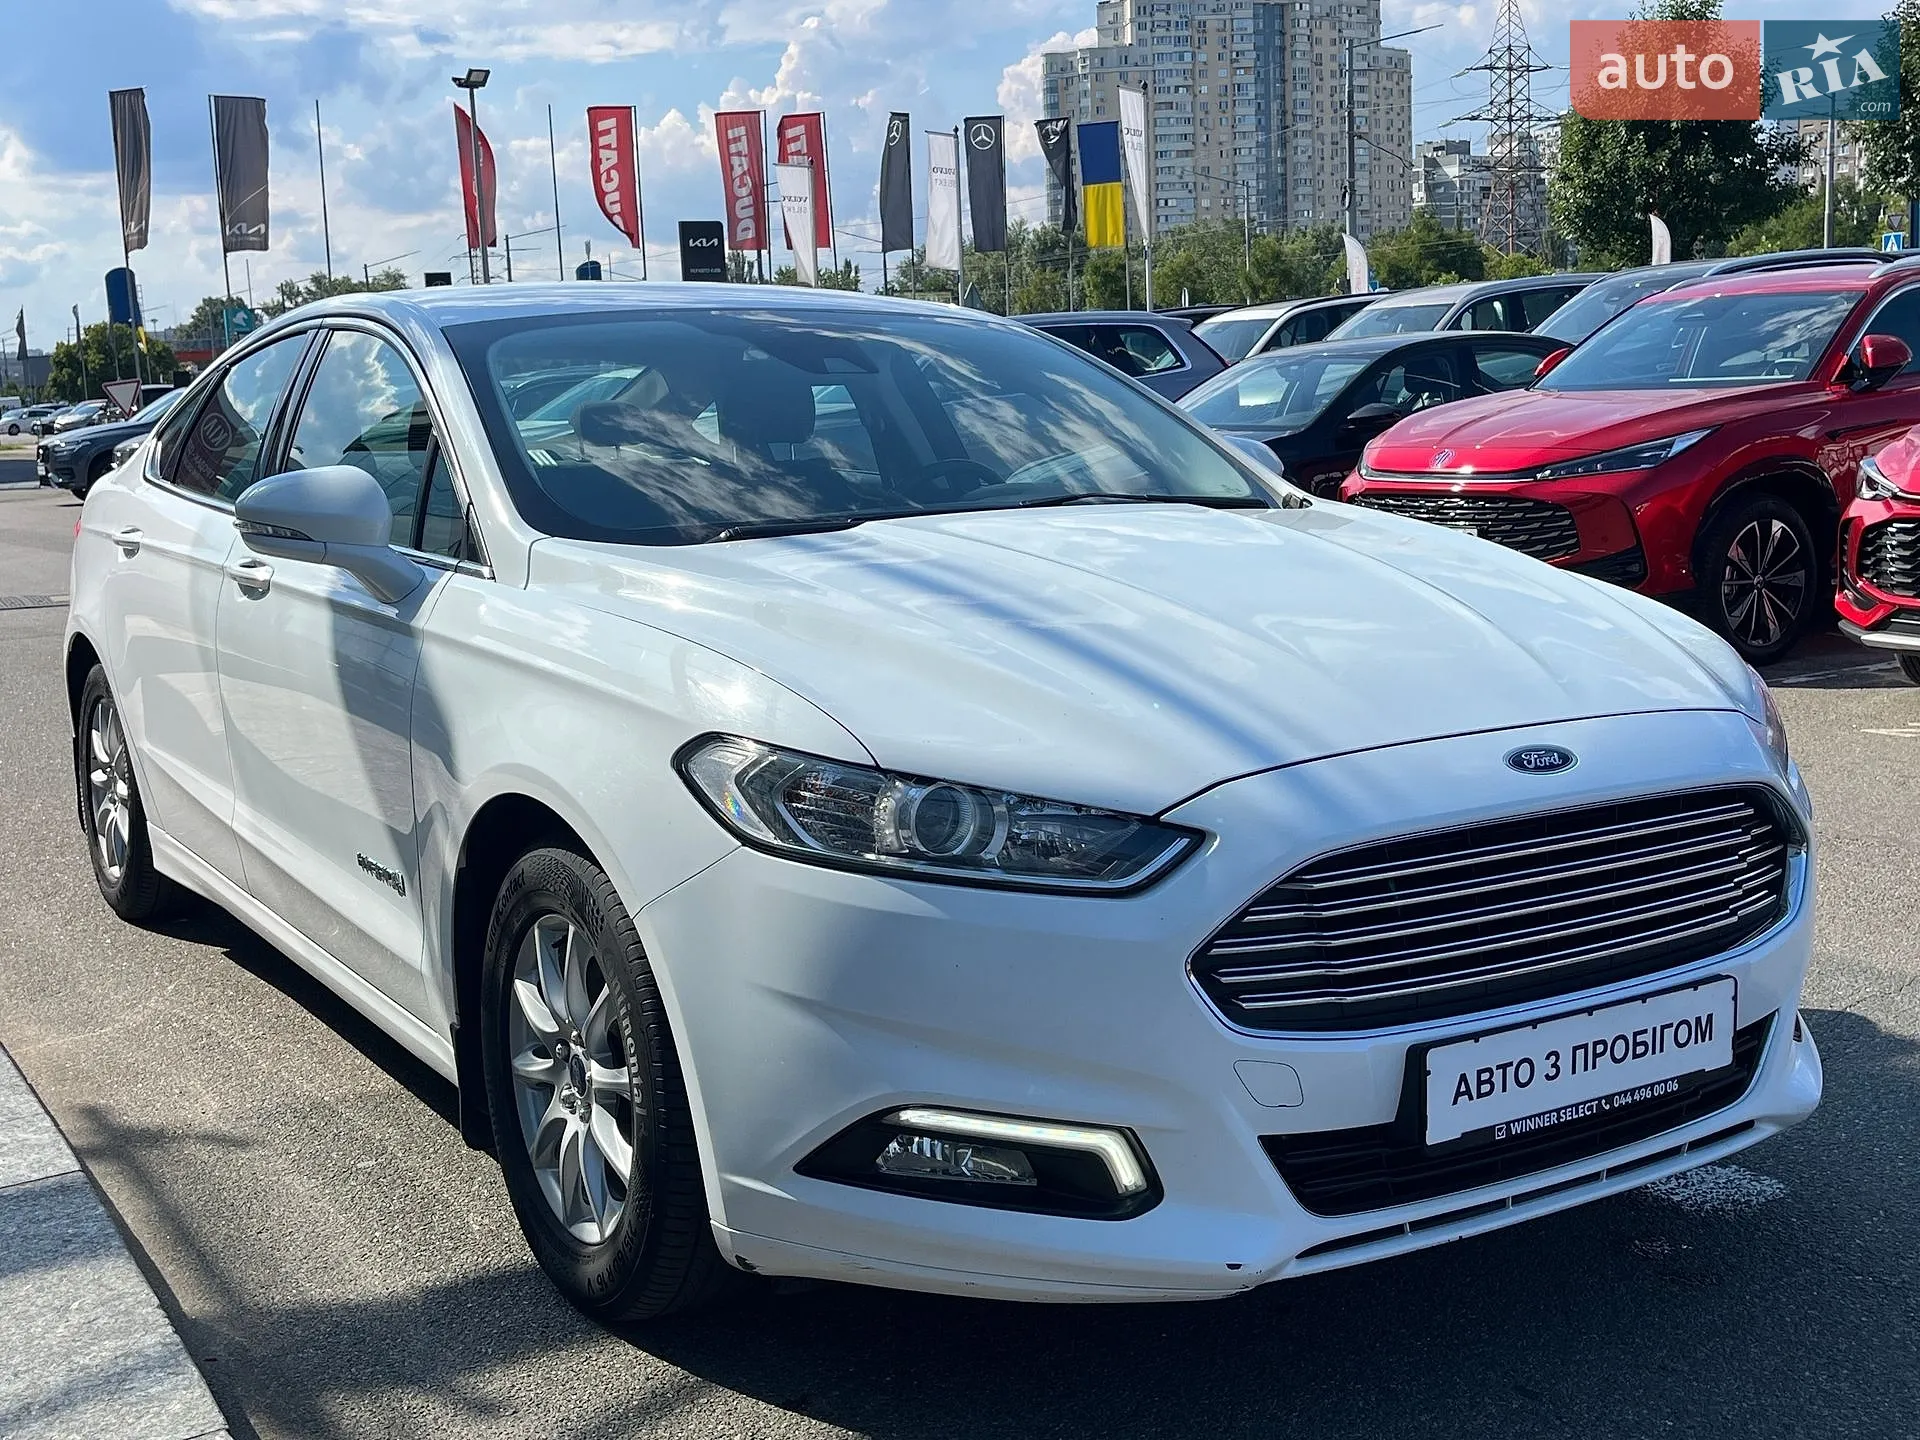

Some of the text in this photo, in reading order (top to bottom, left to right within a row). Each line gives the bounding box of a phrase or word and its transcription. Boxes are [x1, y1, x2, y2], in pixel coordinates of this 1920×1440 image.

[688, 237, 719, 248] KIA
[1521, 750, 1563, 769] Ford
[1451, 1057, 1536, 1106] АВТО
[1571, 1012, 1714, 1075] ПРОБІГОМ
[1510, 1079, 1679, 1135] WINNER SELECT 044 496 00 06
